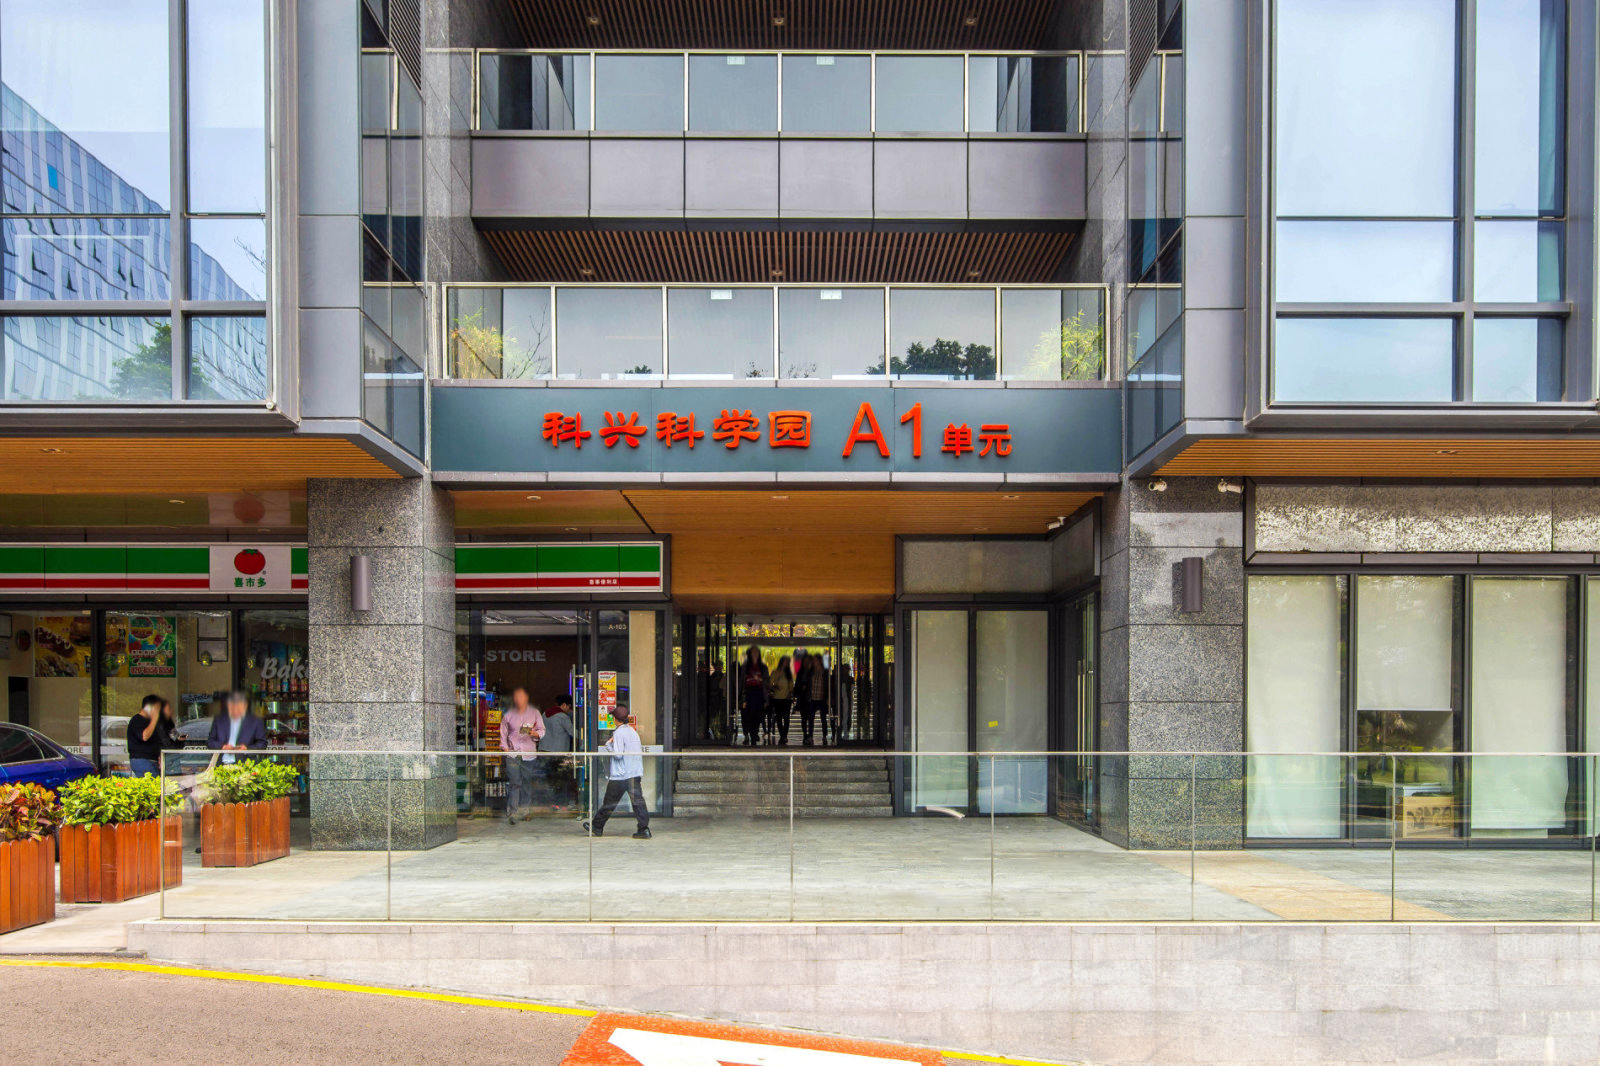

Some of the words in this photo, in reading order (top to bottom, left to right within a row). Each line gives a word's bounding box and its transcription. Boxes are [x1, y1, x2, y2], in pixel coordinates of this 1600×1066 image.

[541, 409, 812, 449] 科兴科学园
